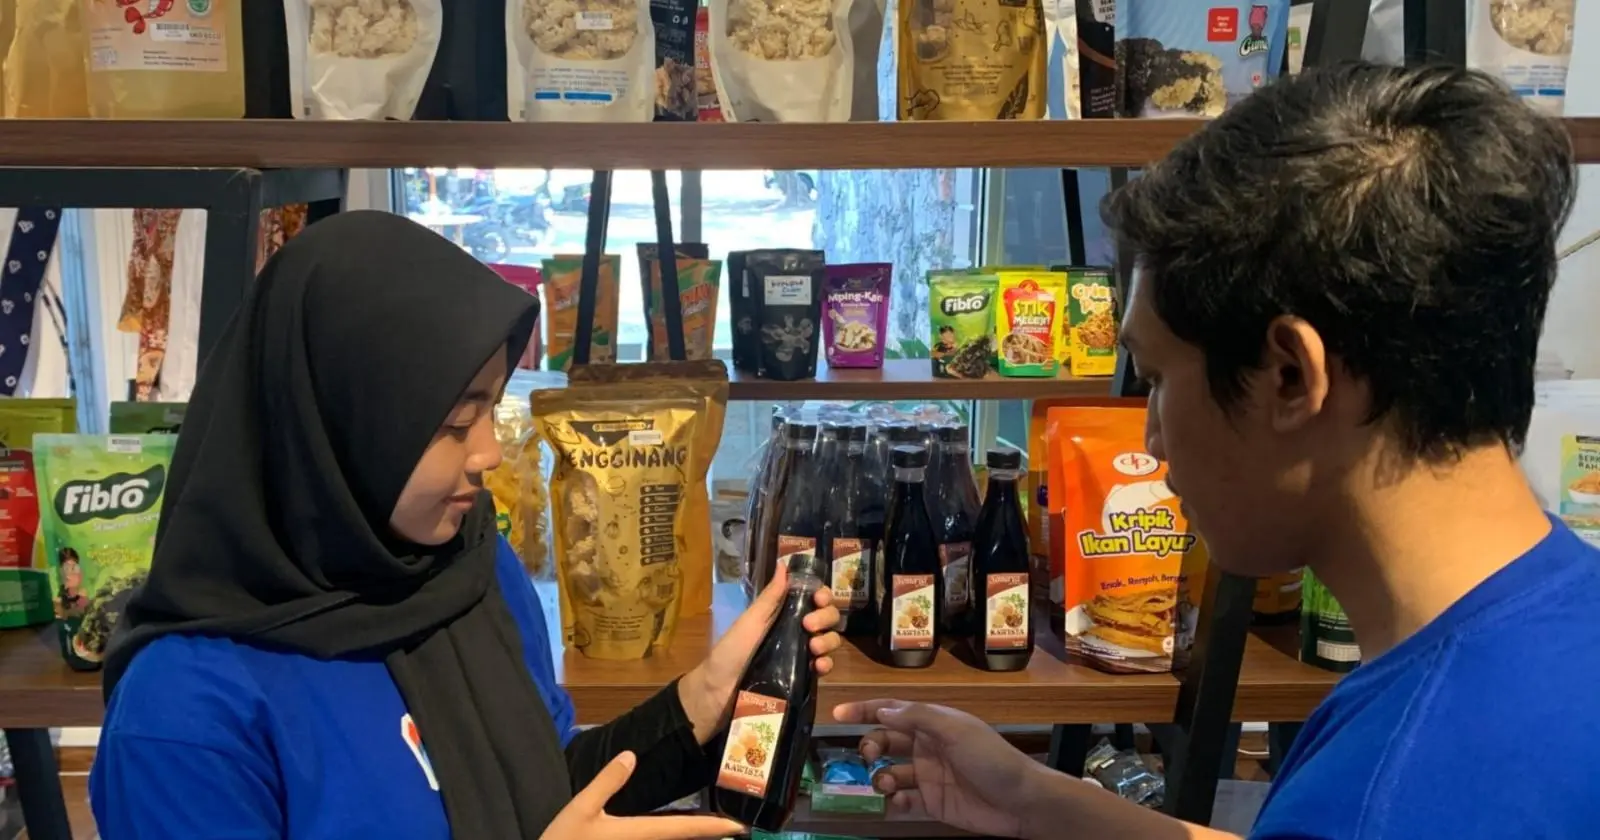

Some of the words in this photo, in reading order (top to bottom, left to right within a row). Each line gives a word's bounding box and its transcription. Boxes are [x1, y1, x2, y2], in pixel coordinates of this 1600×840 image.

[944, 295, 985, 312] Fibro
[1014, 299, 1049, 317] STIK
[562, 446, 687, 469] ENGGINANG
[63, 478, 150, 514] Fibro
[1110, 508, 1174, 532] Kripik
[1080, 531, 1131, 556] Ikan
[1132, 530, 1196, 557] Layur
[725, 763, 764, 778] KAWISTA
